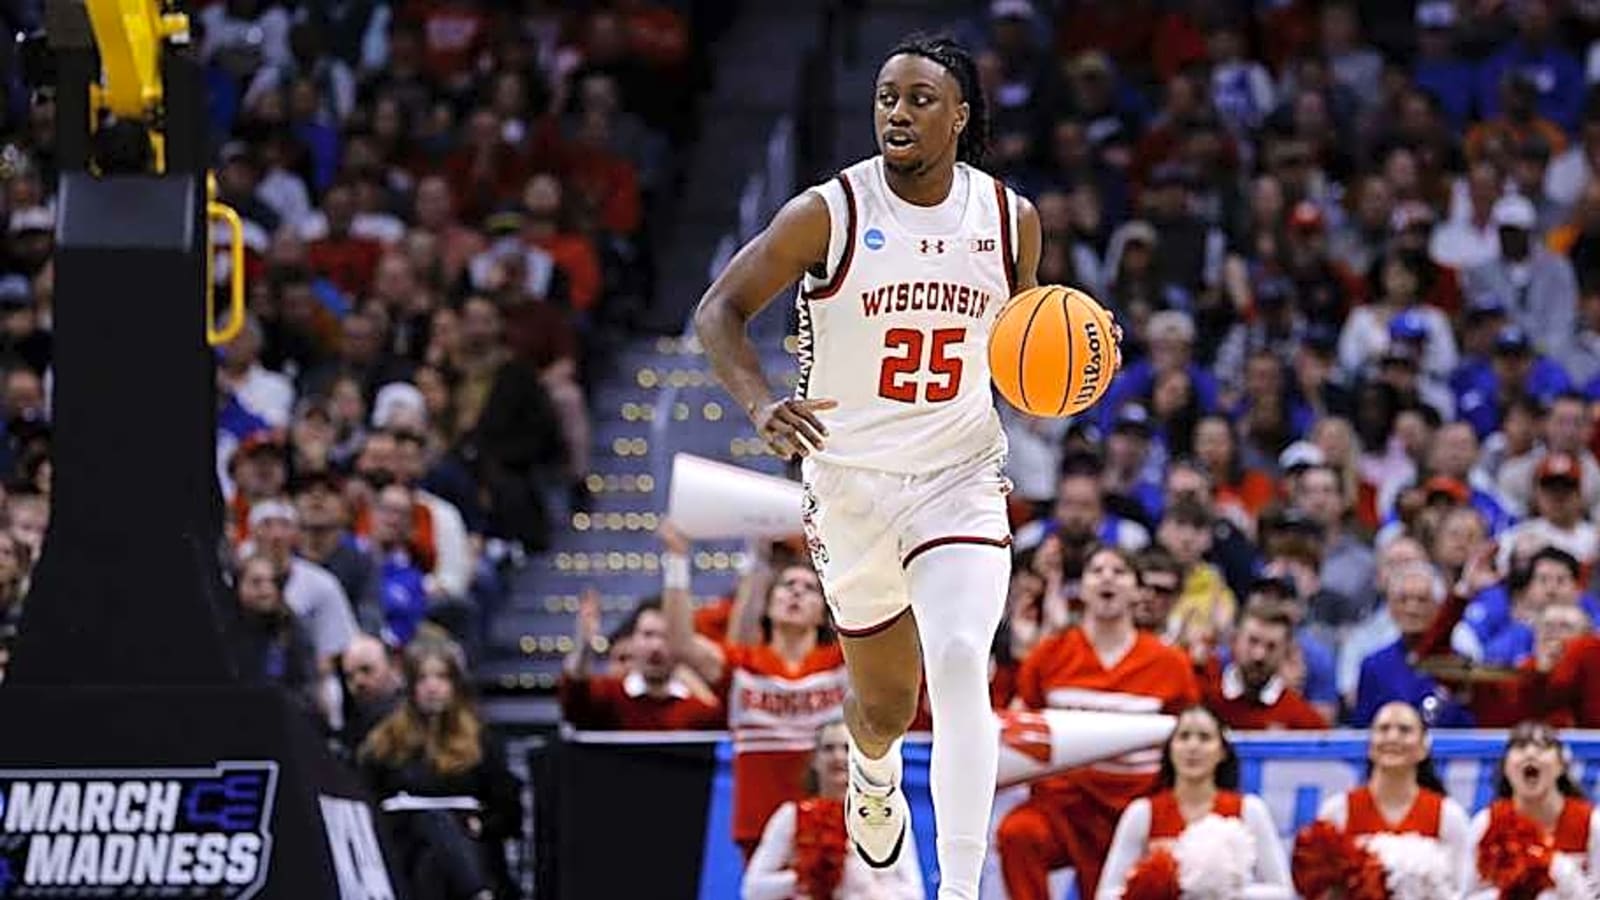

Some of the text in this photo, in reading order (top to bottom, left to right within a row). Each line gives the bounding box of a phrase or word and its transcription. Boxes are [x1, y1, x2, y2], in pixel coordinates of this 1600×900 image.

[861, 282, 990, 319] WISCONSIN
[878, 327, 967, 404] 25
[1072, 322, 1102, 405] Wilson
[4, 781, 182, 833] MARCH
[24, 833, 262, 885] MADNESS
